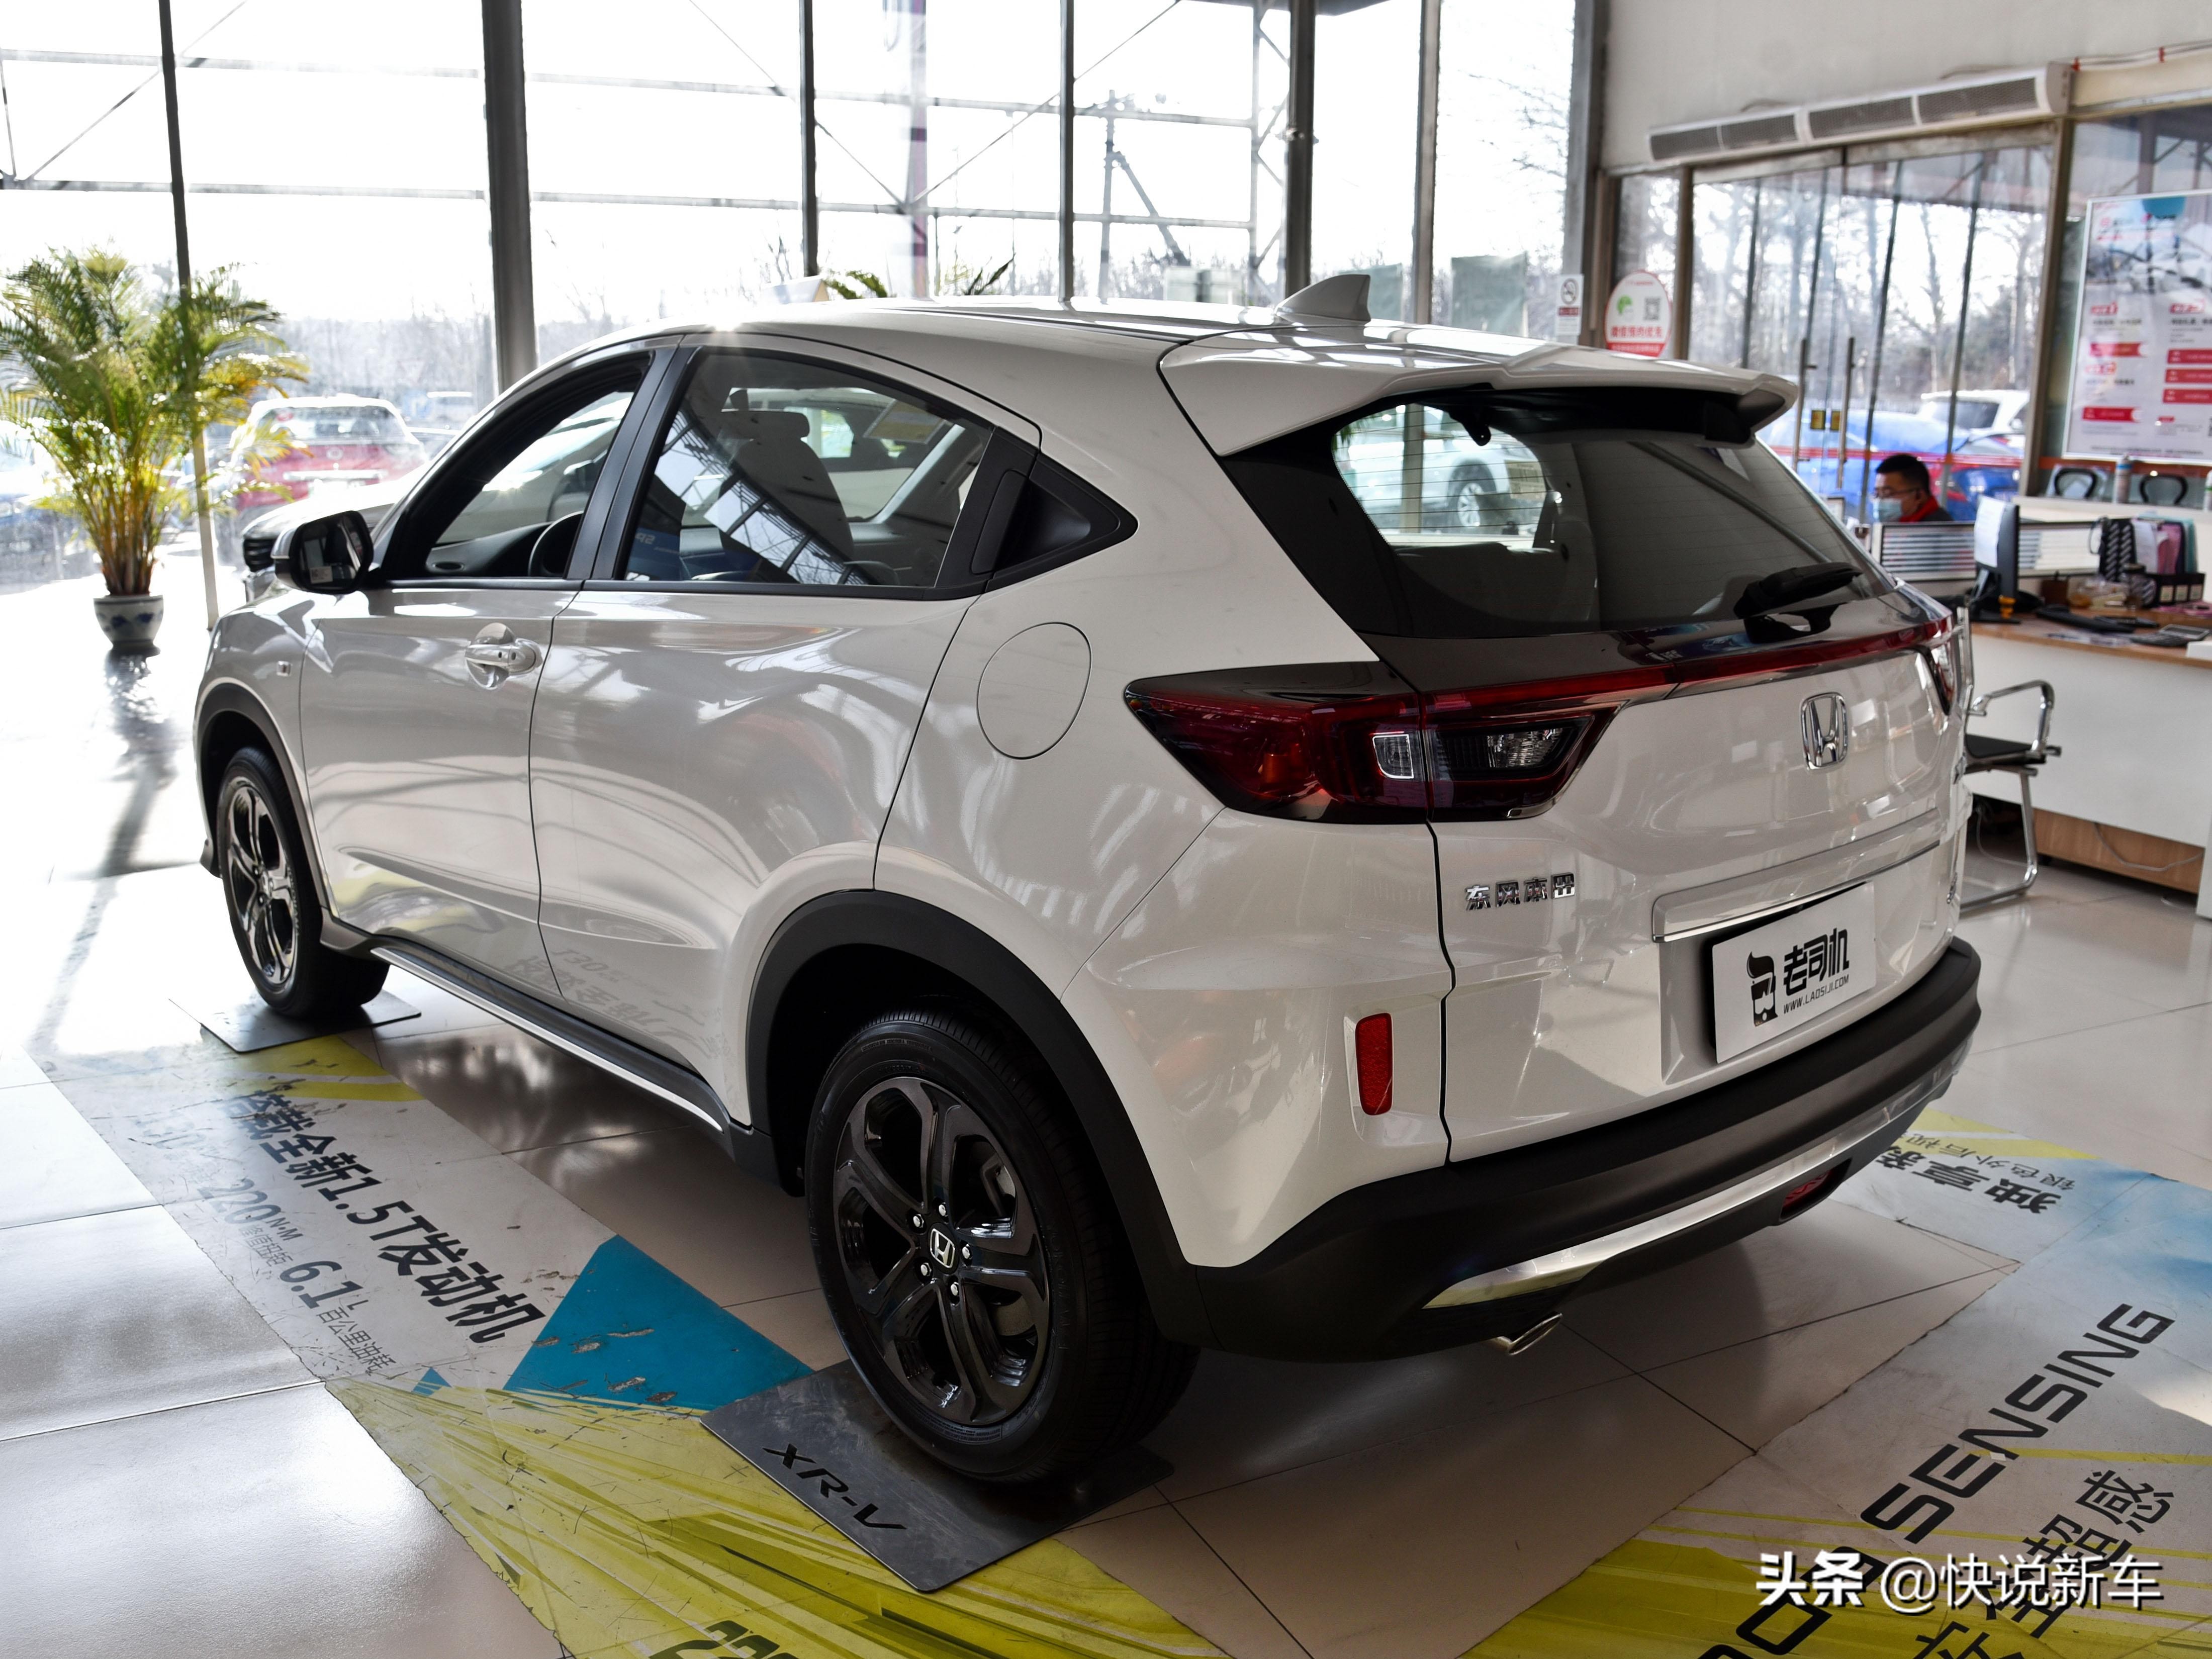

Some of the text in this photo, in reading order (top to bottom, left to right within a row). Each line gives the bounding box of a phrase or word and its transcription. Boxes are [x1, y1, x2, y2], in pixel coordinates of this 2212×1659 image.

[1783, 927, 1850, 996] 老司机
[1783, 974, 1850, 1015] WWW.LAOSIJI.COM
[1901, 1133, 2075, 1190] 银色外后视
[316, 1306, 397, 1372] 百公里油耗
[1861, 1303, 2176, 1545] SENSING
[762, 1443, 907, 1531] XR-V
